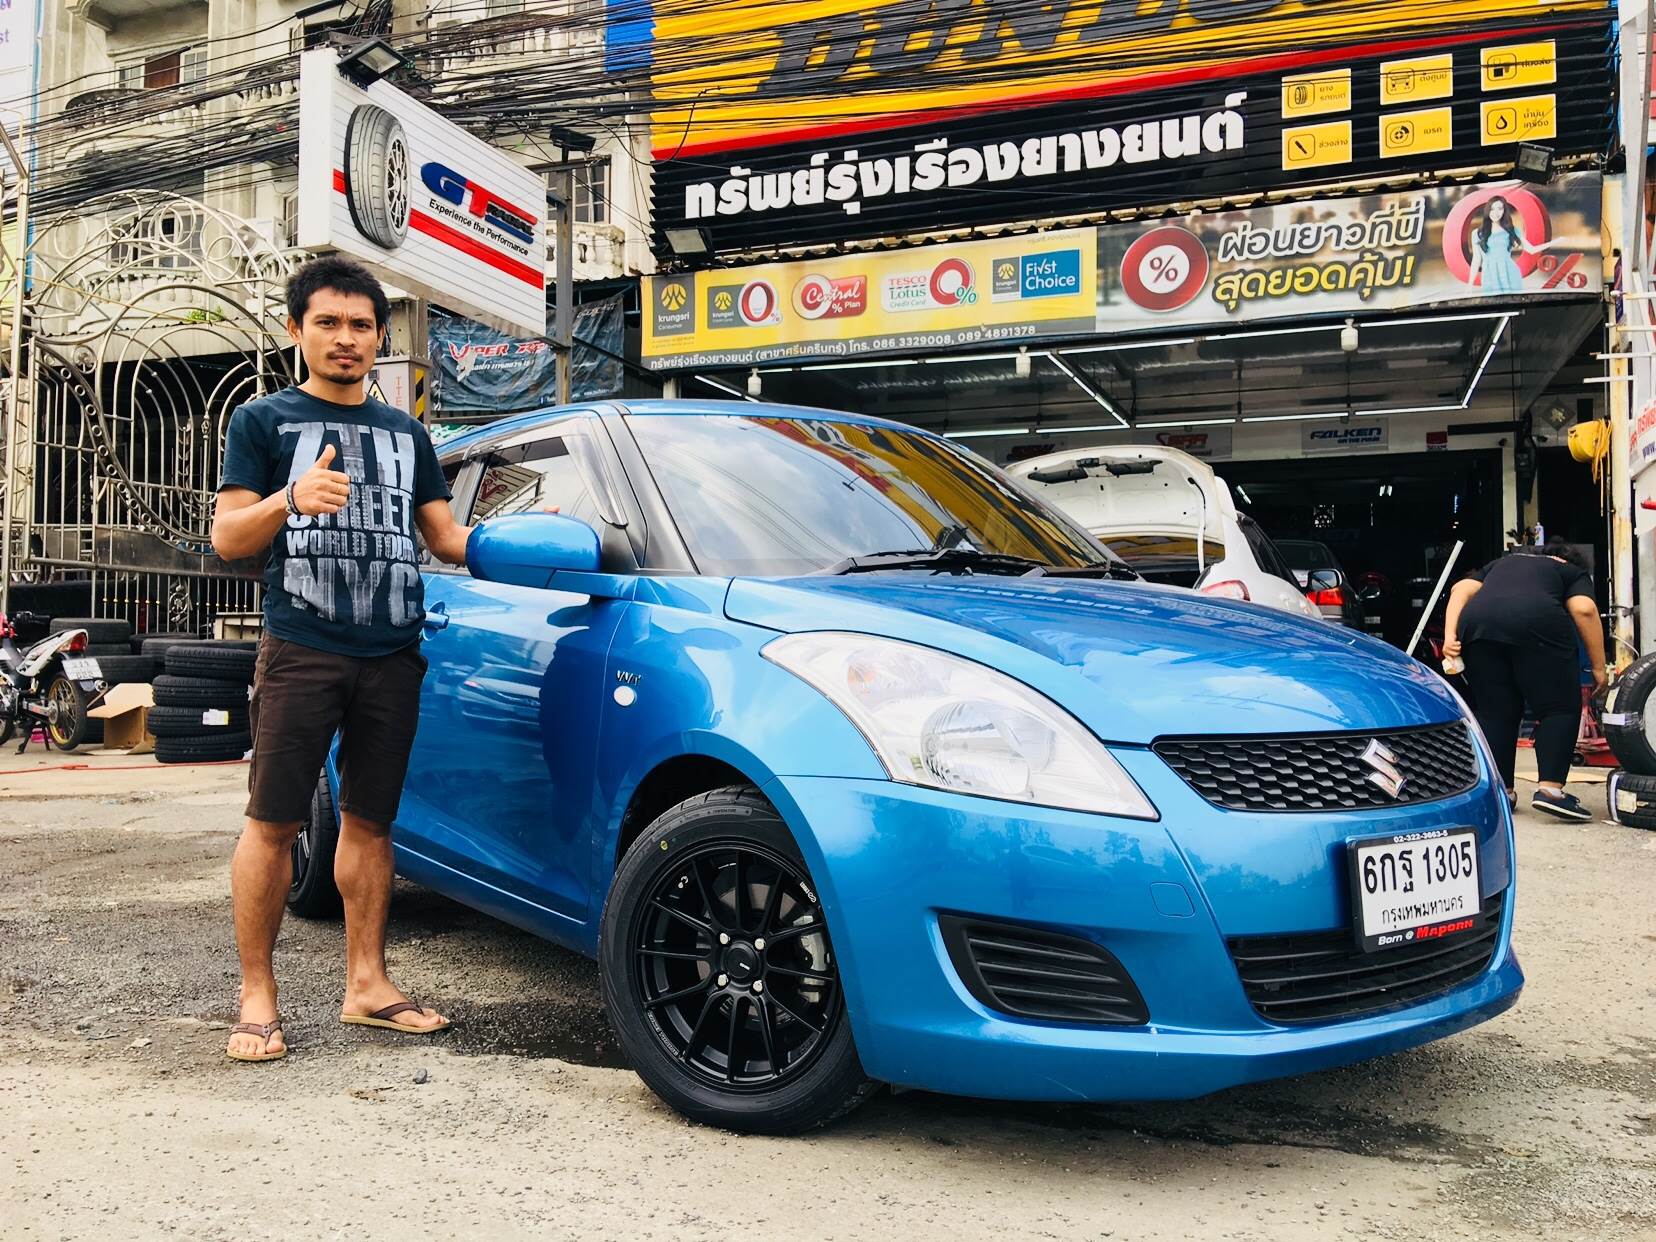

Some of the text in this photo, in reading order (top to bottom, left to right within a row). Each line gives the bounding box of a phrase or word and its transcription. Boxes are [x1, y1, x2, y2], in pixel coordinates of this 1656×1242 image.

[684, 92, 1247, 219] ทรัพย์รุ่งเรืองยางยนต์
[420, 162, 538, 219] GT
[429, 198, 529, 256] Experience the Performance
[1220, 198, 1425, 261] ผ่อนยาวที่นี่
[805, 280, 862, 304] Central
[889, 275, 927, 287] TESCO
[889, 288, 927, 300] Lotus
[1025, 274, 1076, 290] Choice
[1215, 252, 1416, 310] สุดยอดคุ้ม!
[658, 312, 690, 323] krungsri
[844, 300, 861, 309] Plan
[448, 340, 510, 362] VPER
[873, 338, 896, 349] 086
[958, 331, 982, 343] 089
[985, 325, 1036, 338] 4891378
[1310, 427, 1382, 440] FALKEN
[277, 421, 415, 494] 7TH
[286, 529, 416, 562] WORLD TOUR
[283, 557, 420, 627] NYC
[1364, 841, 1472, 894] 6กฐ 1305
[1382, 896, 1463, 928] กรุงเทพมหานคร
[1378, 934, 1403, 946] Born
